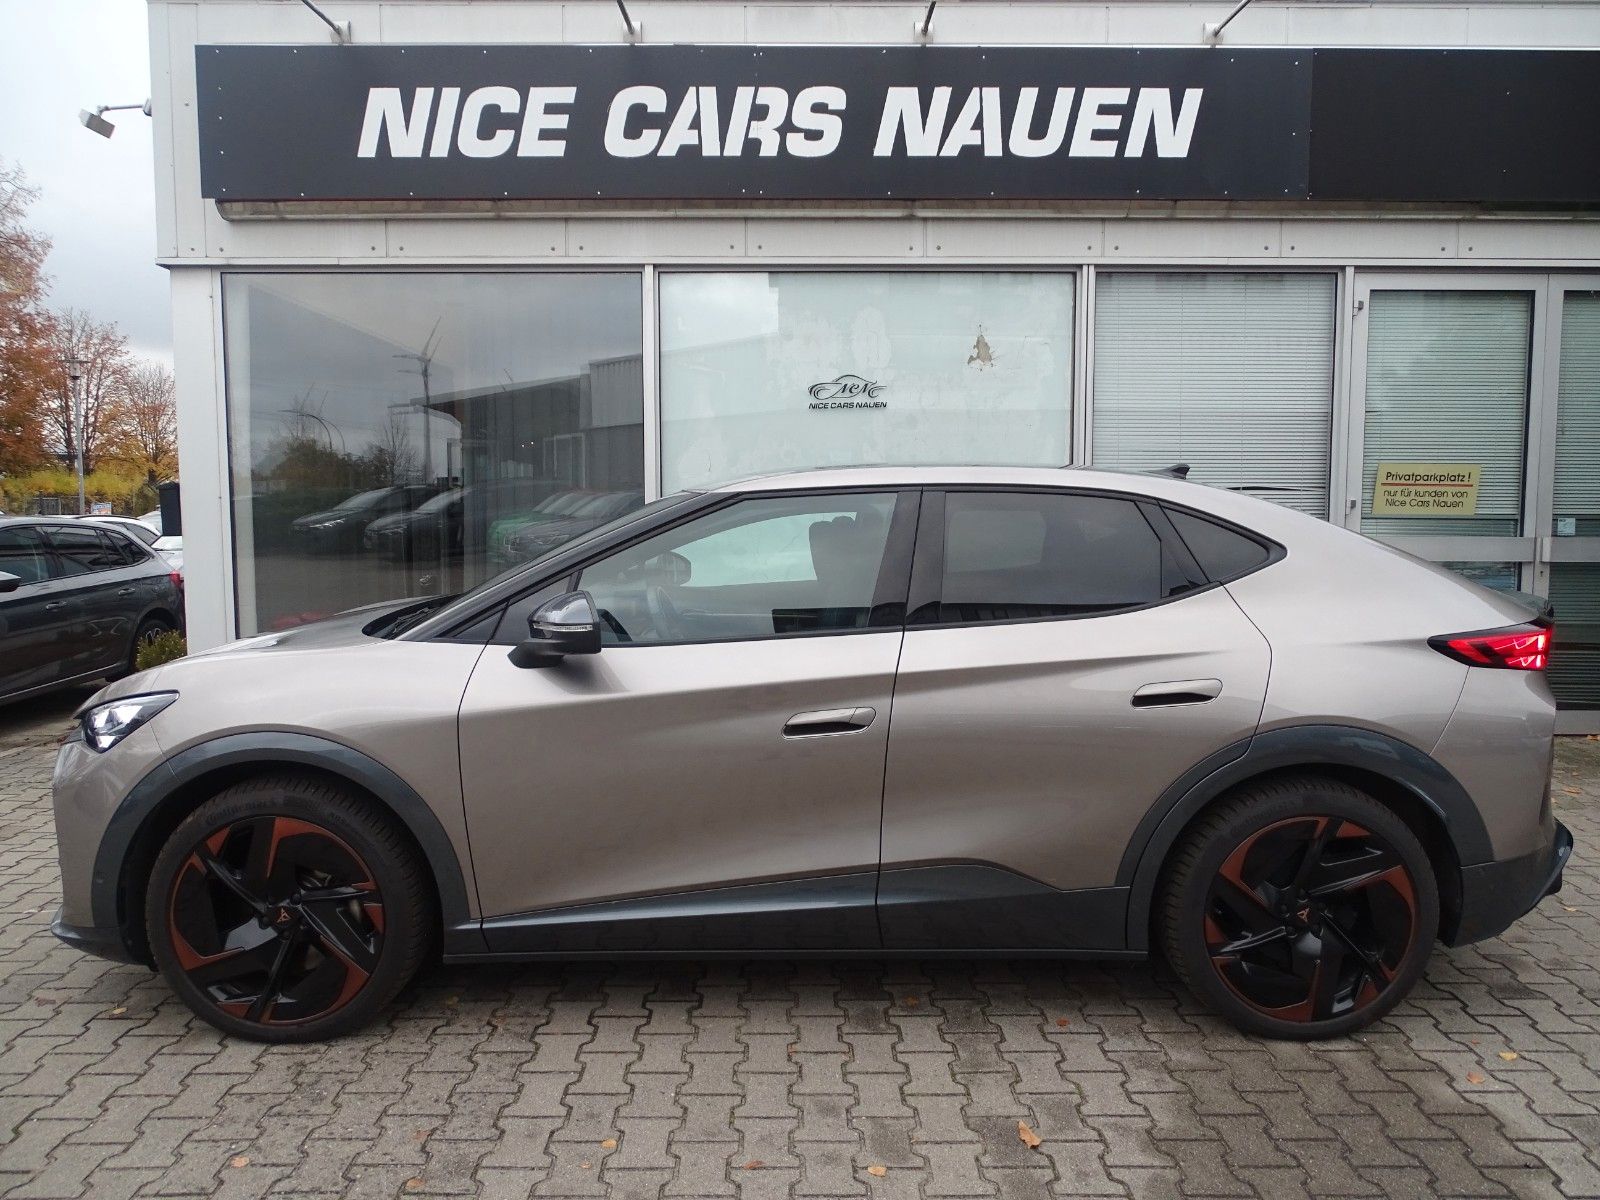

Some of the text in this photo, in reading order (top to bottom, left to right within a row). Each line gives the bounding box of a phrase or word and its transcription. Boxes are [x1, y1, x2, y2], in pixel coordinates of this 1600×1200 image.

[357, 85, 1204, 159] NICE CARS NAUEN
[855, 401, 887, 409] NAUEN
[1383, 487, 1468, 498] nur für kunden von
[1385, 498, 1464, 508] Nice Cars Nauen
